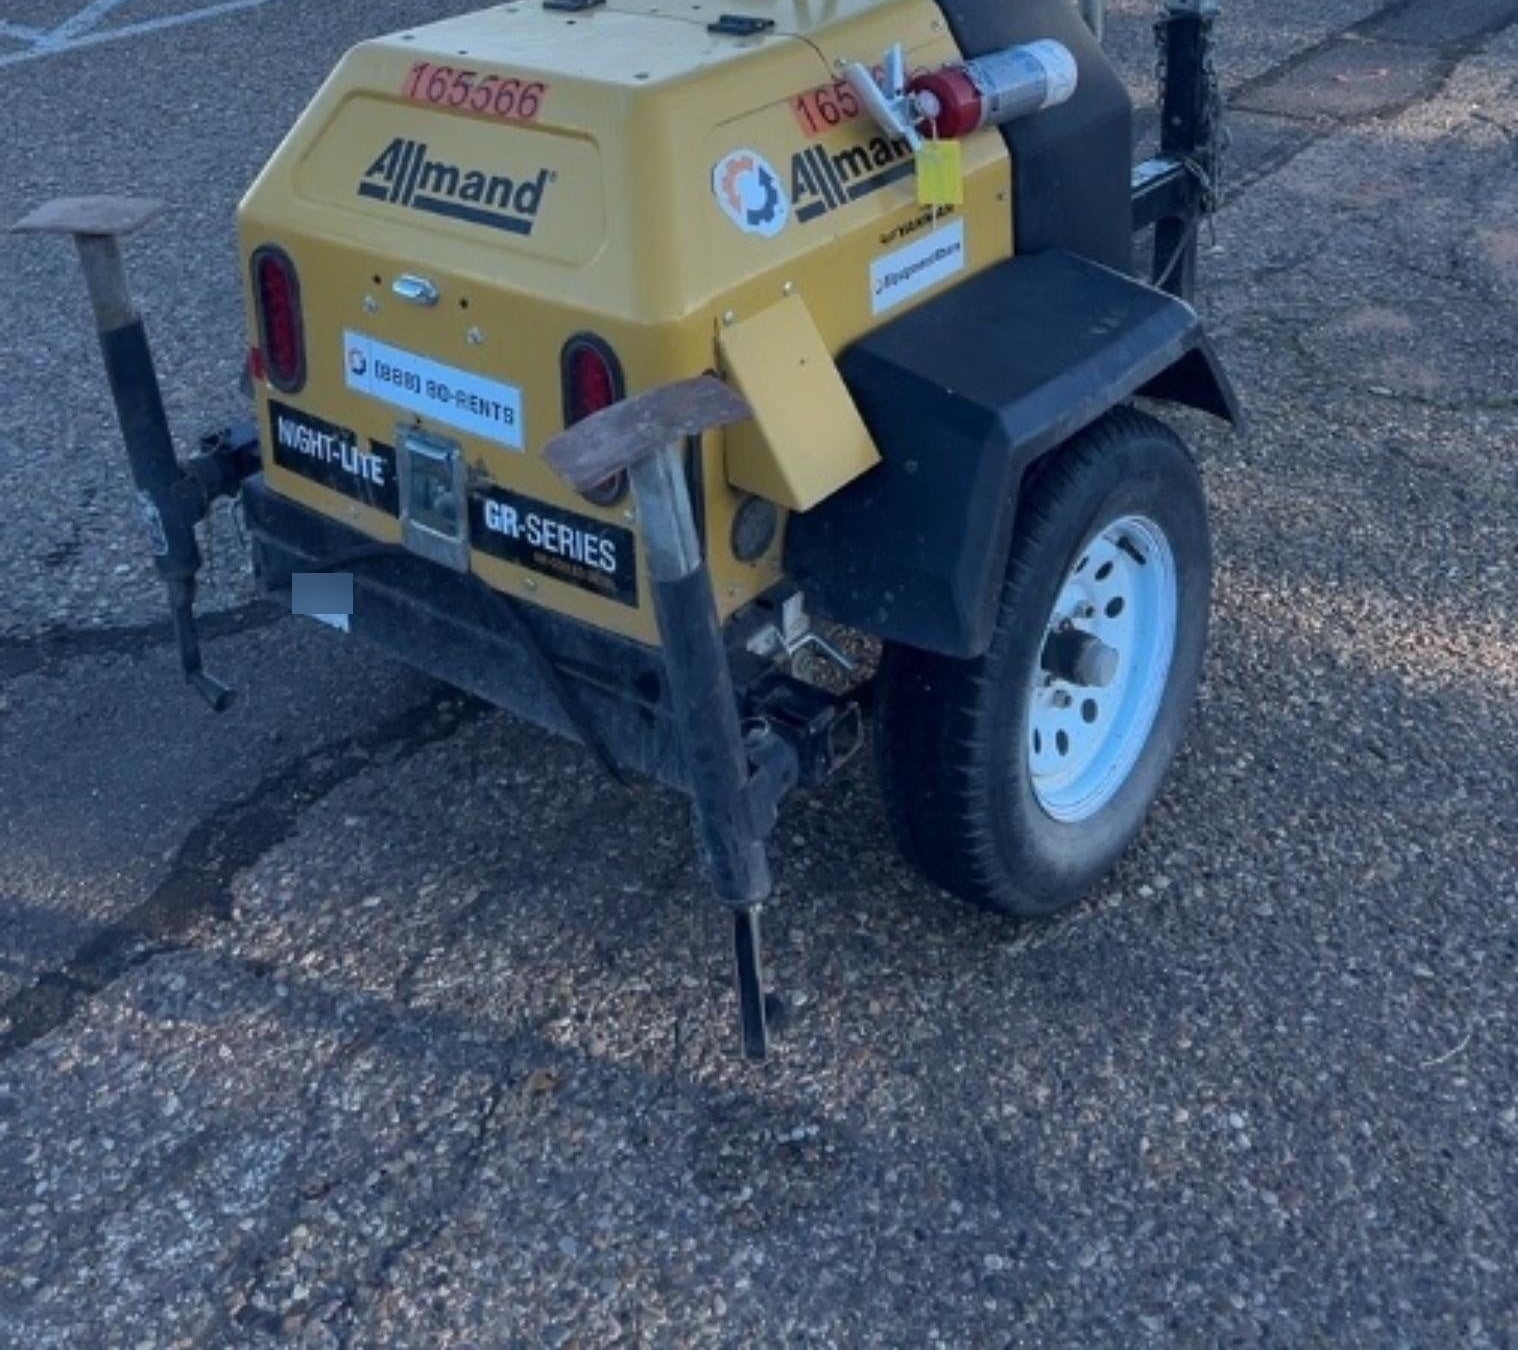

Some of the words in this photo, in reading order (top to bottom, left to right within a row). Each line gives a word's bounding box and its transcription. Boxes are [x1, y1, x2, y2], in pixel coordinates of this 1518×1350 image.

[408, 61, 546, 119] 165566
[360, 137, 550, 222] Allmand
[791, 135, 914, 211] Allman
[277, 414, 385, 487] NIGHT-LITE
[484, 498, 617, 575] GR-SERIES
